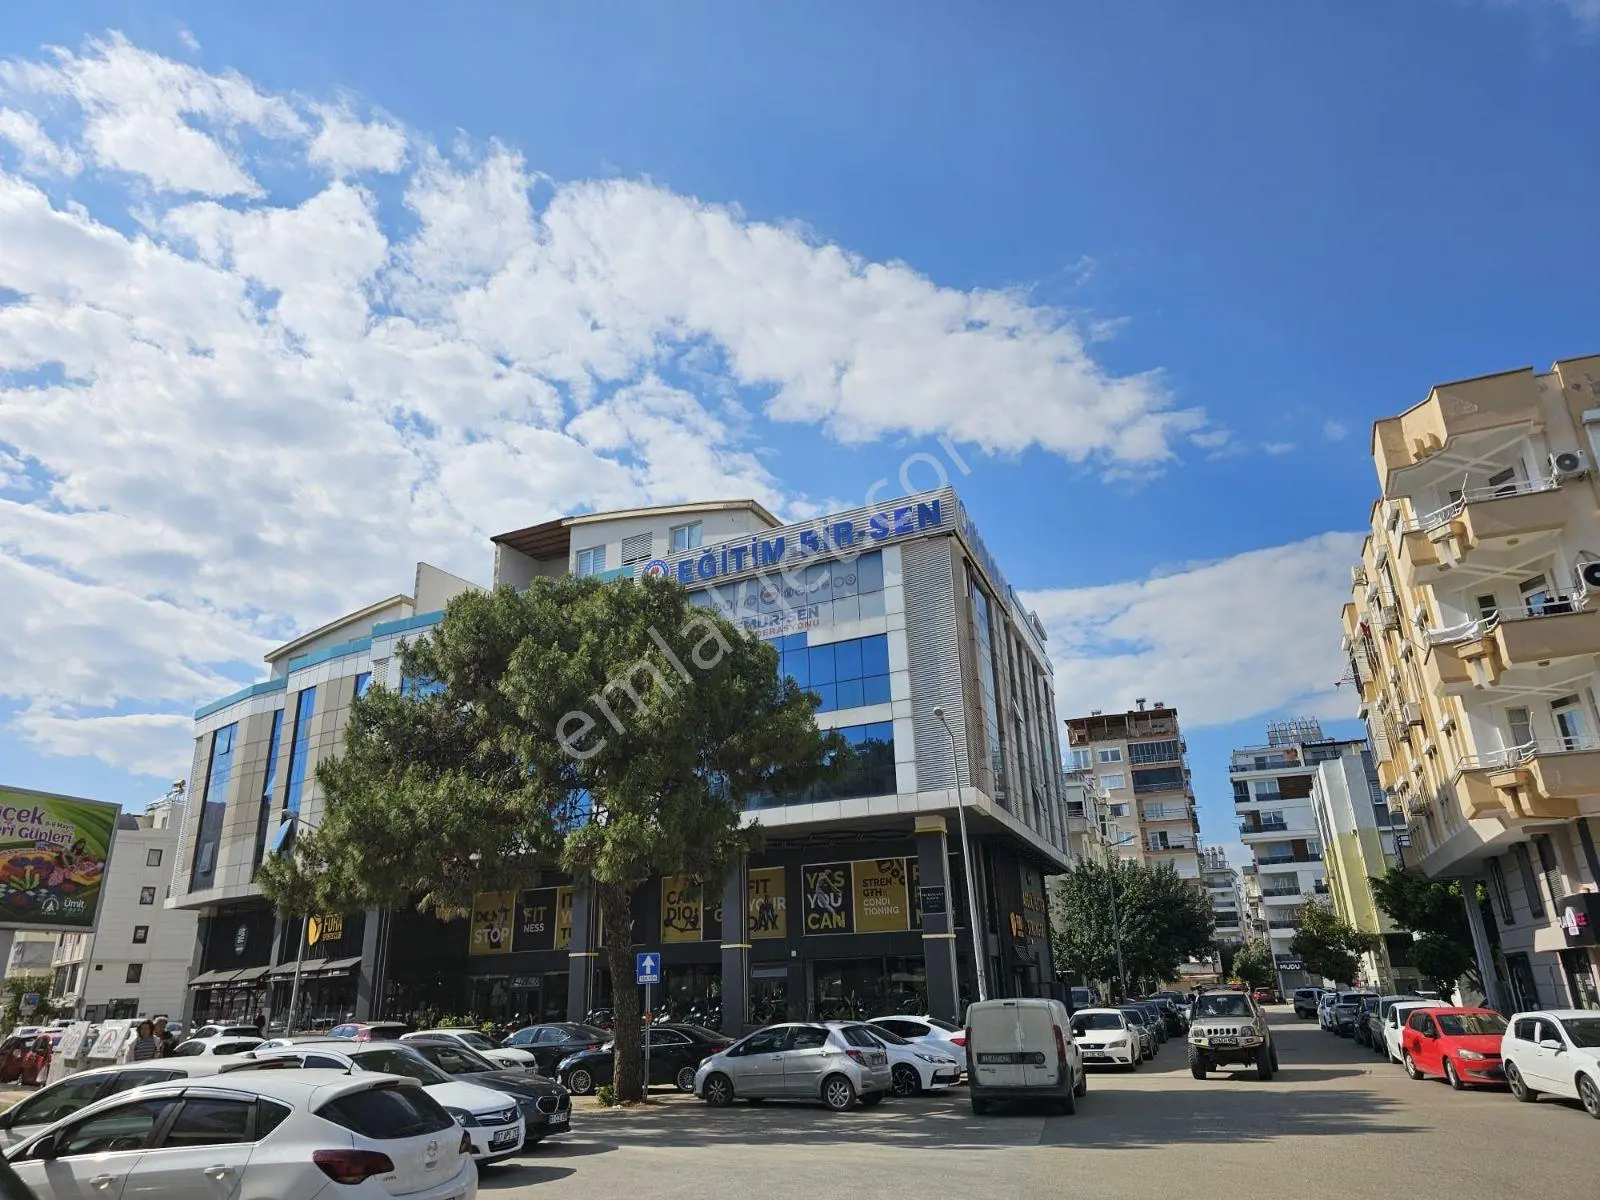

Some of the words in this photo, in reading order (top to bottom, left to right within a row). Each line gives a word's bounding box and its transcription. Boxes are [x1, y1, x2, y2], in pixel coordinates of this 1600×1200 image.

[677, 535, 786, 585] EĞİTİM
[799, 499, 942, 557] BİR-SEN
[18, 827, 73, 843] Günleri
[807, 892, 843, 909] YOU
[863, 897, 890, 906] CONDI
[863, 905, 900, 916] TIONING
[523, 922, 545, 933] NESS
[807, 911, 846, 930] CAN
[473, 926, 510, 944] STOP
